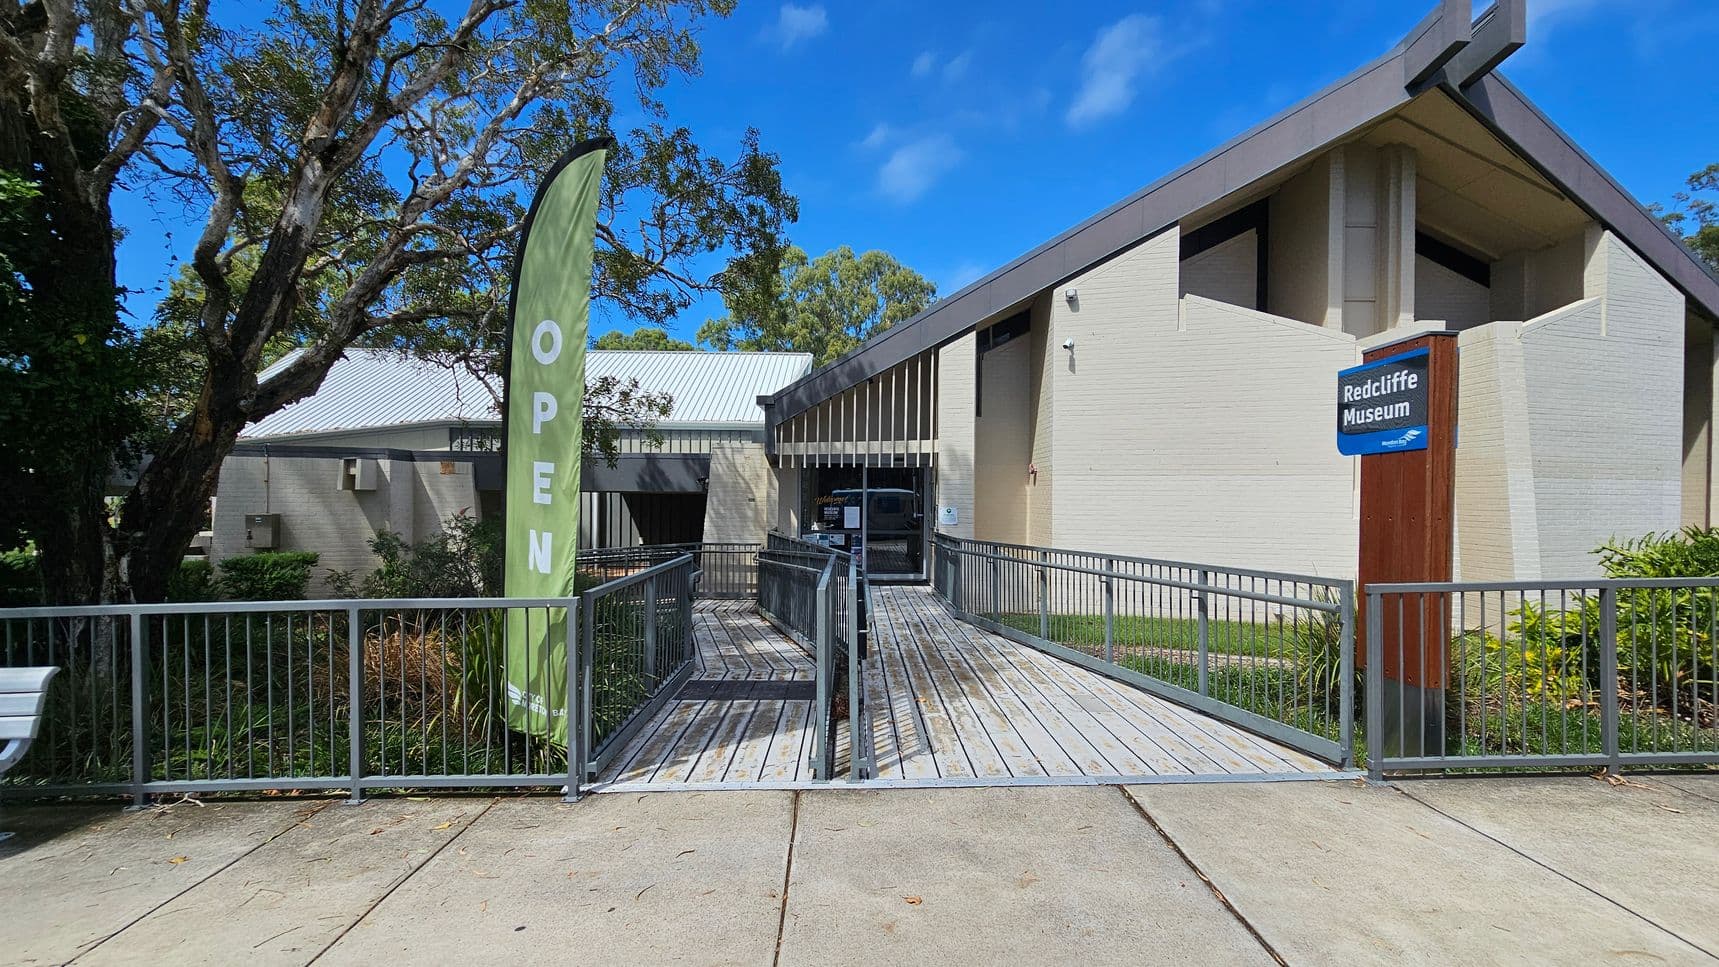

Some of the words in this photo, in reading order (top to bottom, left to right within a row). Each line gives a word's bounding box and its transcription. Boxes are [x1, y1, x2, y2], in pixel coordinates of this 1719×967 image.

[1343, 369, 1418, 403] Redcliffe
[1343, 401, 1410, 426] Museum
[528, 319, 563, 574] OPEN
